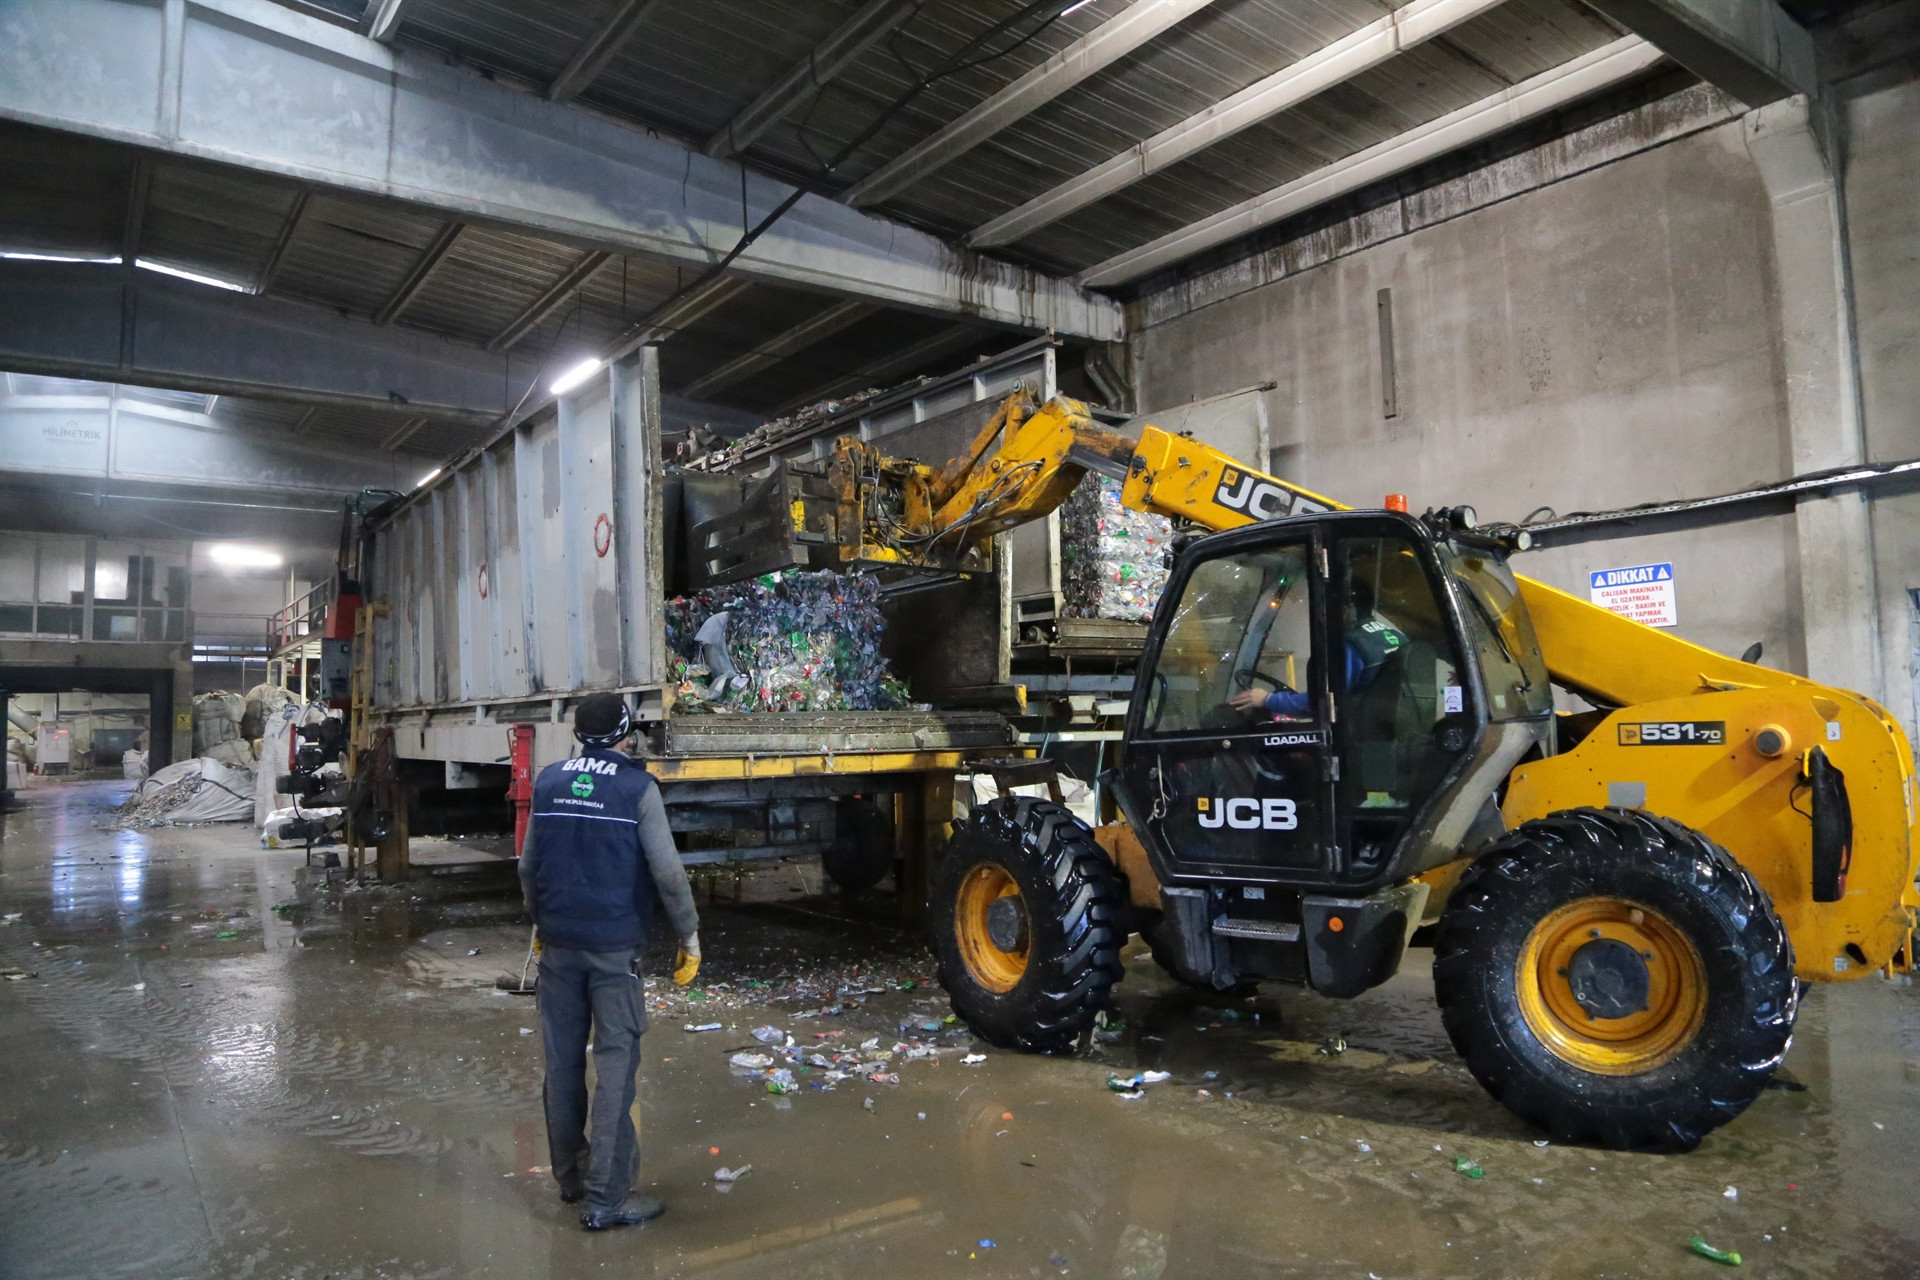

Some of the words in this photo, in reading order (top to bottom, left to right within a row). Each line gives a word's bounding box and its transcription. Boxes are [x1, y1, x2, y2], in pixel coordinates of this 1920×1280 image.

[1607, 567, 1654, 586] DİKKAT
[1658, 600, 1667, 608] VE
[1264, 734, 1320, 746] LOADALL
[1641, 723, 1721, 741] 531-70
[562, 757, 618, 776] GAMA
[1198, 797, 1298, 830] JCB
